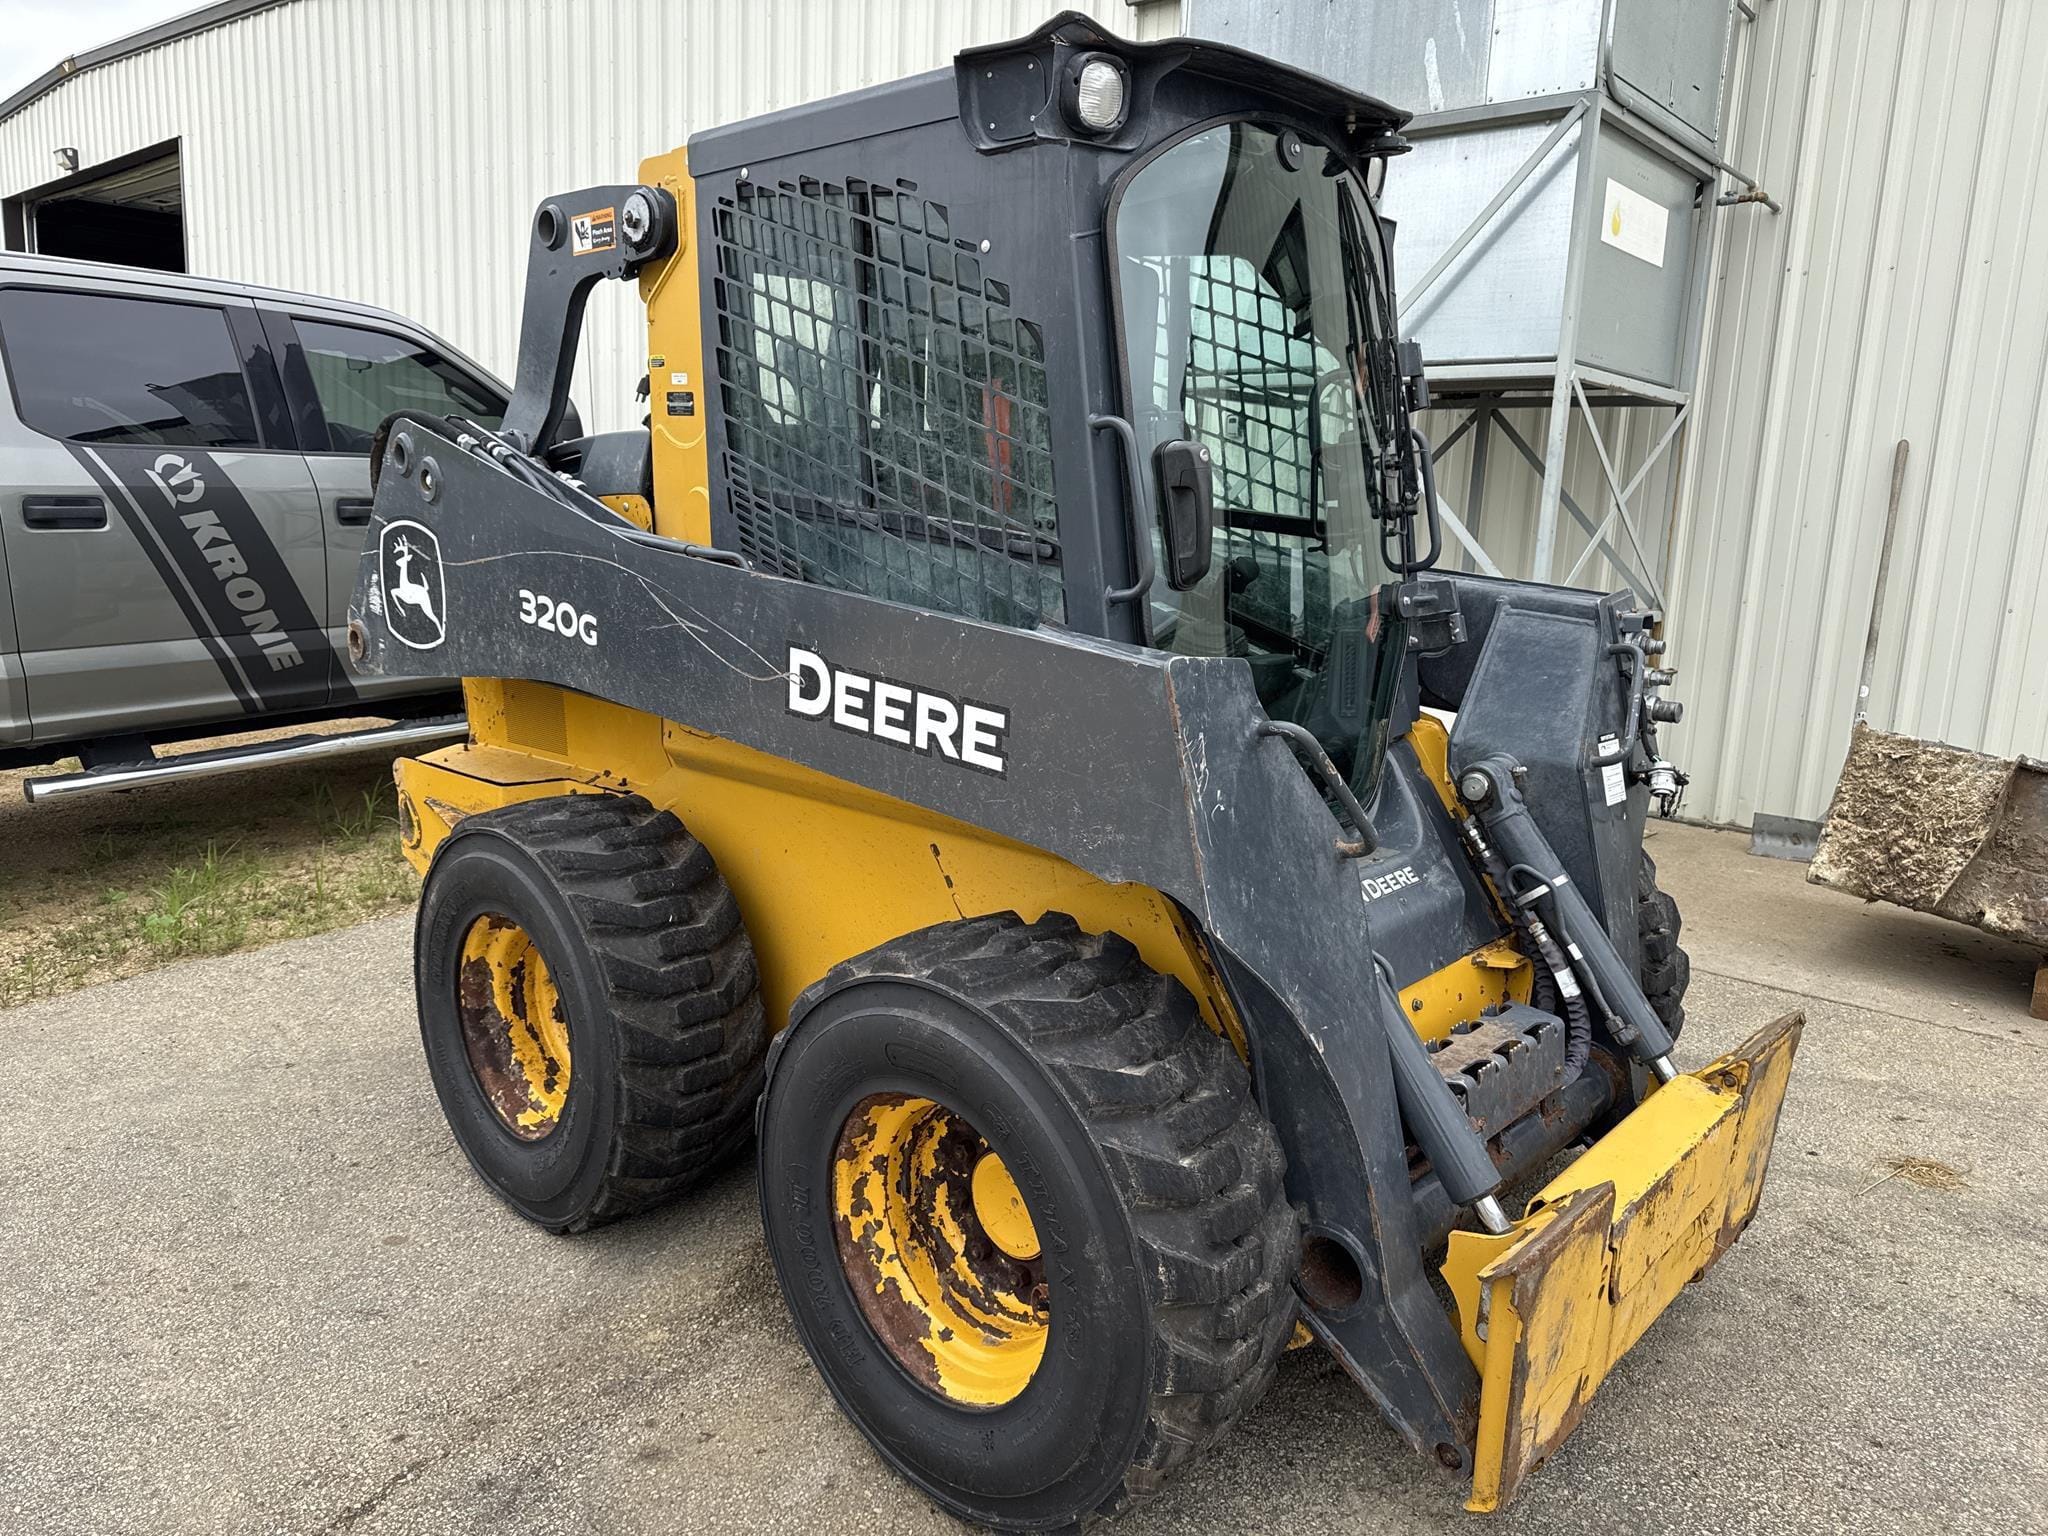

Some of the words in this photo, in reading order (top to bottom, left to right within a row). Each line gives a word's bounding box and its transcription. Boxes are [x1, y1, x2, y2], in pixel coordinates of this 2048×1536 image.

[179, 509, 304, 672] KRONE
[519, 589, 597, 646] 320G
[789, 646, 1006, 772] DEERE
[1361, 866, 1420, 899] DEERE
